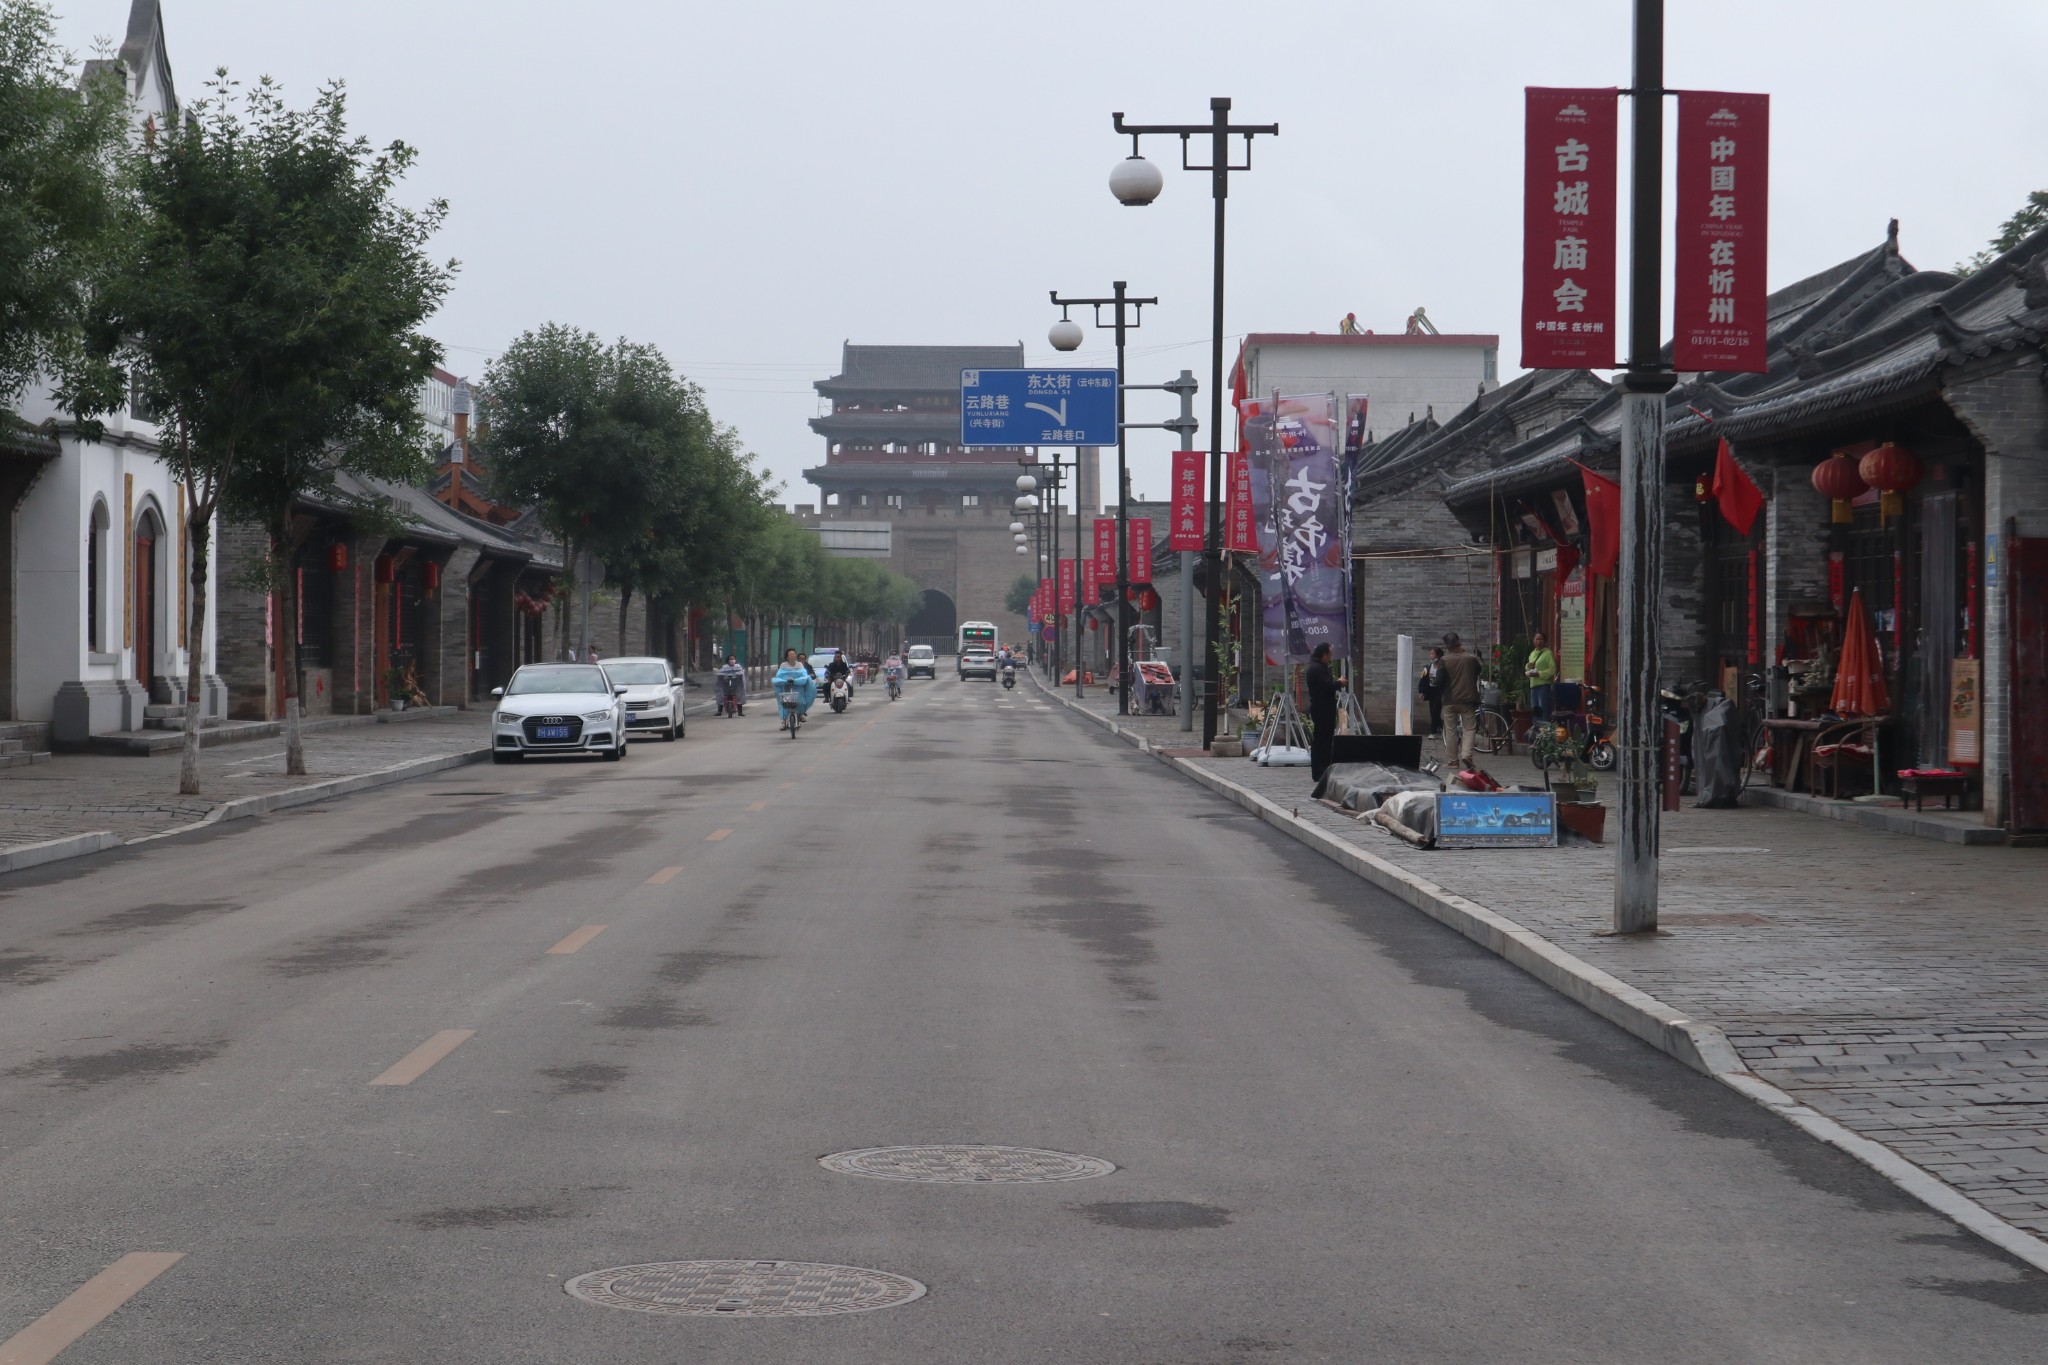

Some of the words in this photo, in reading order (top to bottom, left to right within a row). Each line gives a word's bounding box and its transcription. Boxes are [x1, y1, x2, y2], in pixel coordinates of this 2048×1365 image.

[1535, 320, 1568, 332] 中国年
[1572, 322, 1604, 334] 在忻州
[1027, 374, 1071, 389] 东大街
[965, 395, 1010, 410] 云路巷
[1041, 430, 1085, 441] 云路巷口
